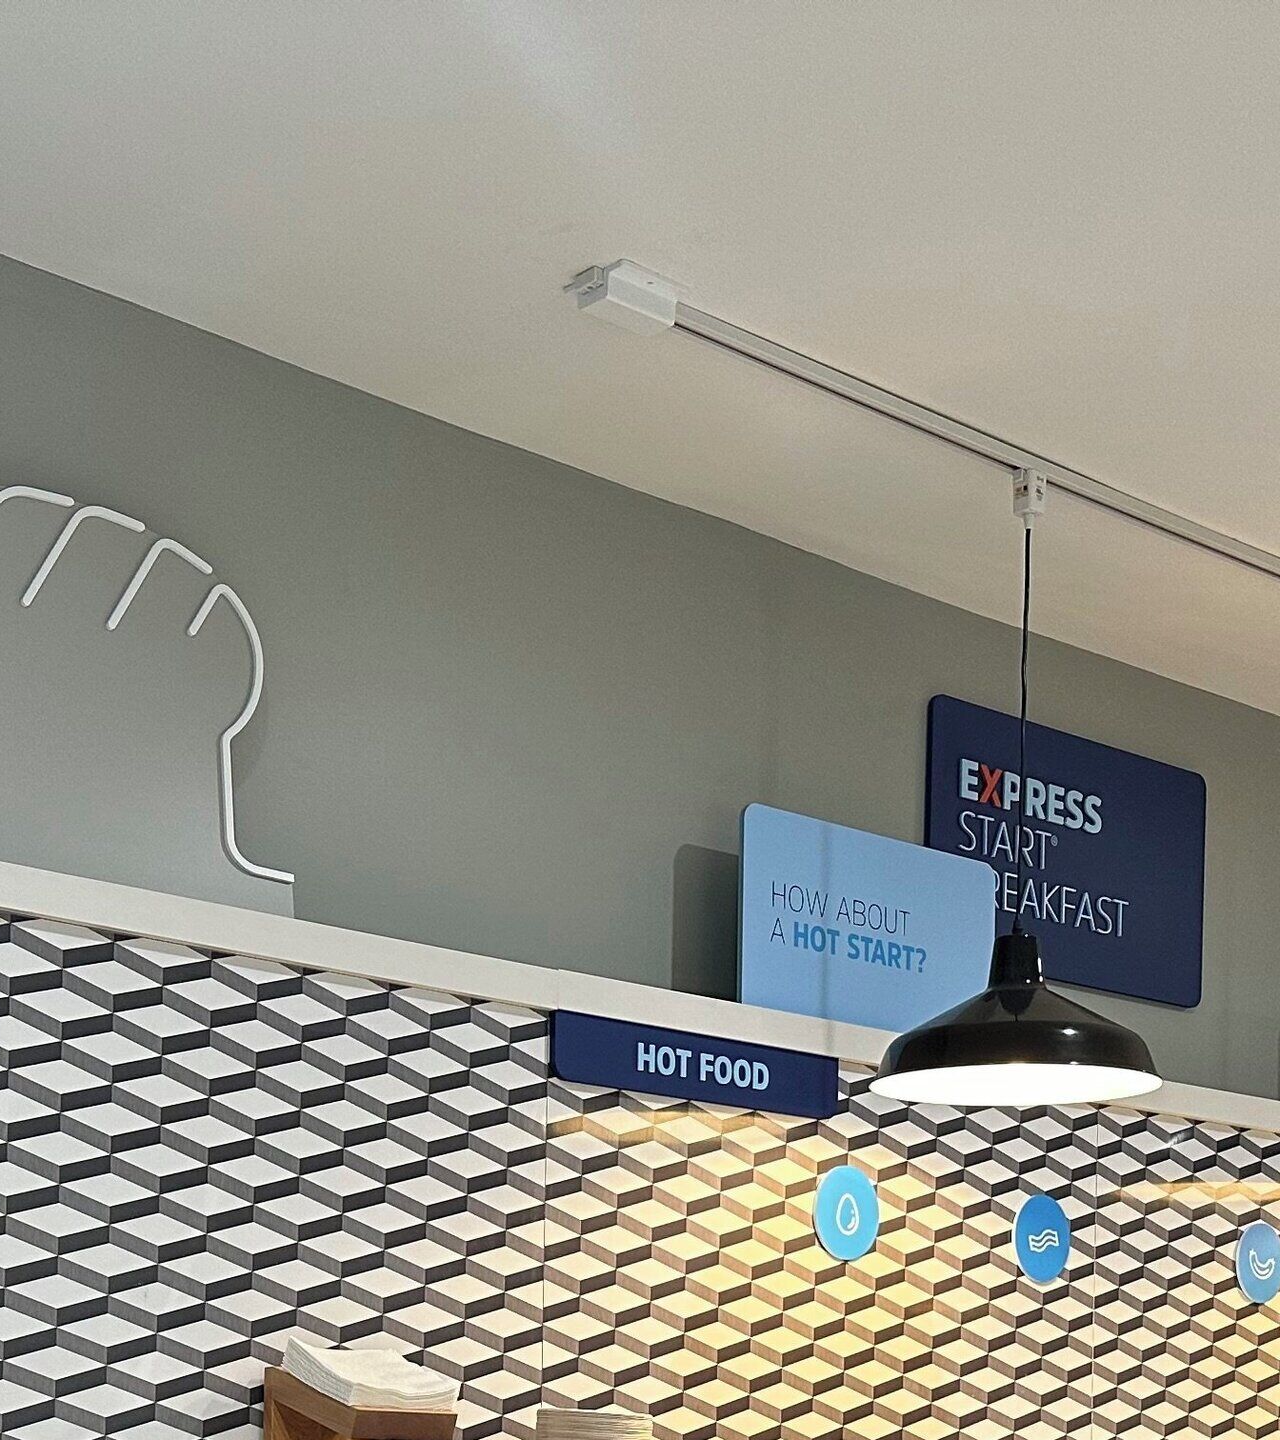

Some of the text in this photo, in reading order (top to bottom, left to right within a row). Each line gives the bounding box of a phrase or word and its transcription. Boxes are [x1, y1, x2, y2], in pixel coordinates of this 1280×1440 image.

[959, 758, 1103, 834] EXPRESS
[772, 880, 911, 936] HOW ABOUT
[994, 869, 1129, 937] EAKFAST
[770, 917, 927, 973] A HOT START?
[637, 1042, 770, 1091] HOT FOOD
